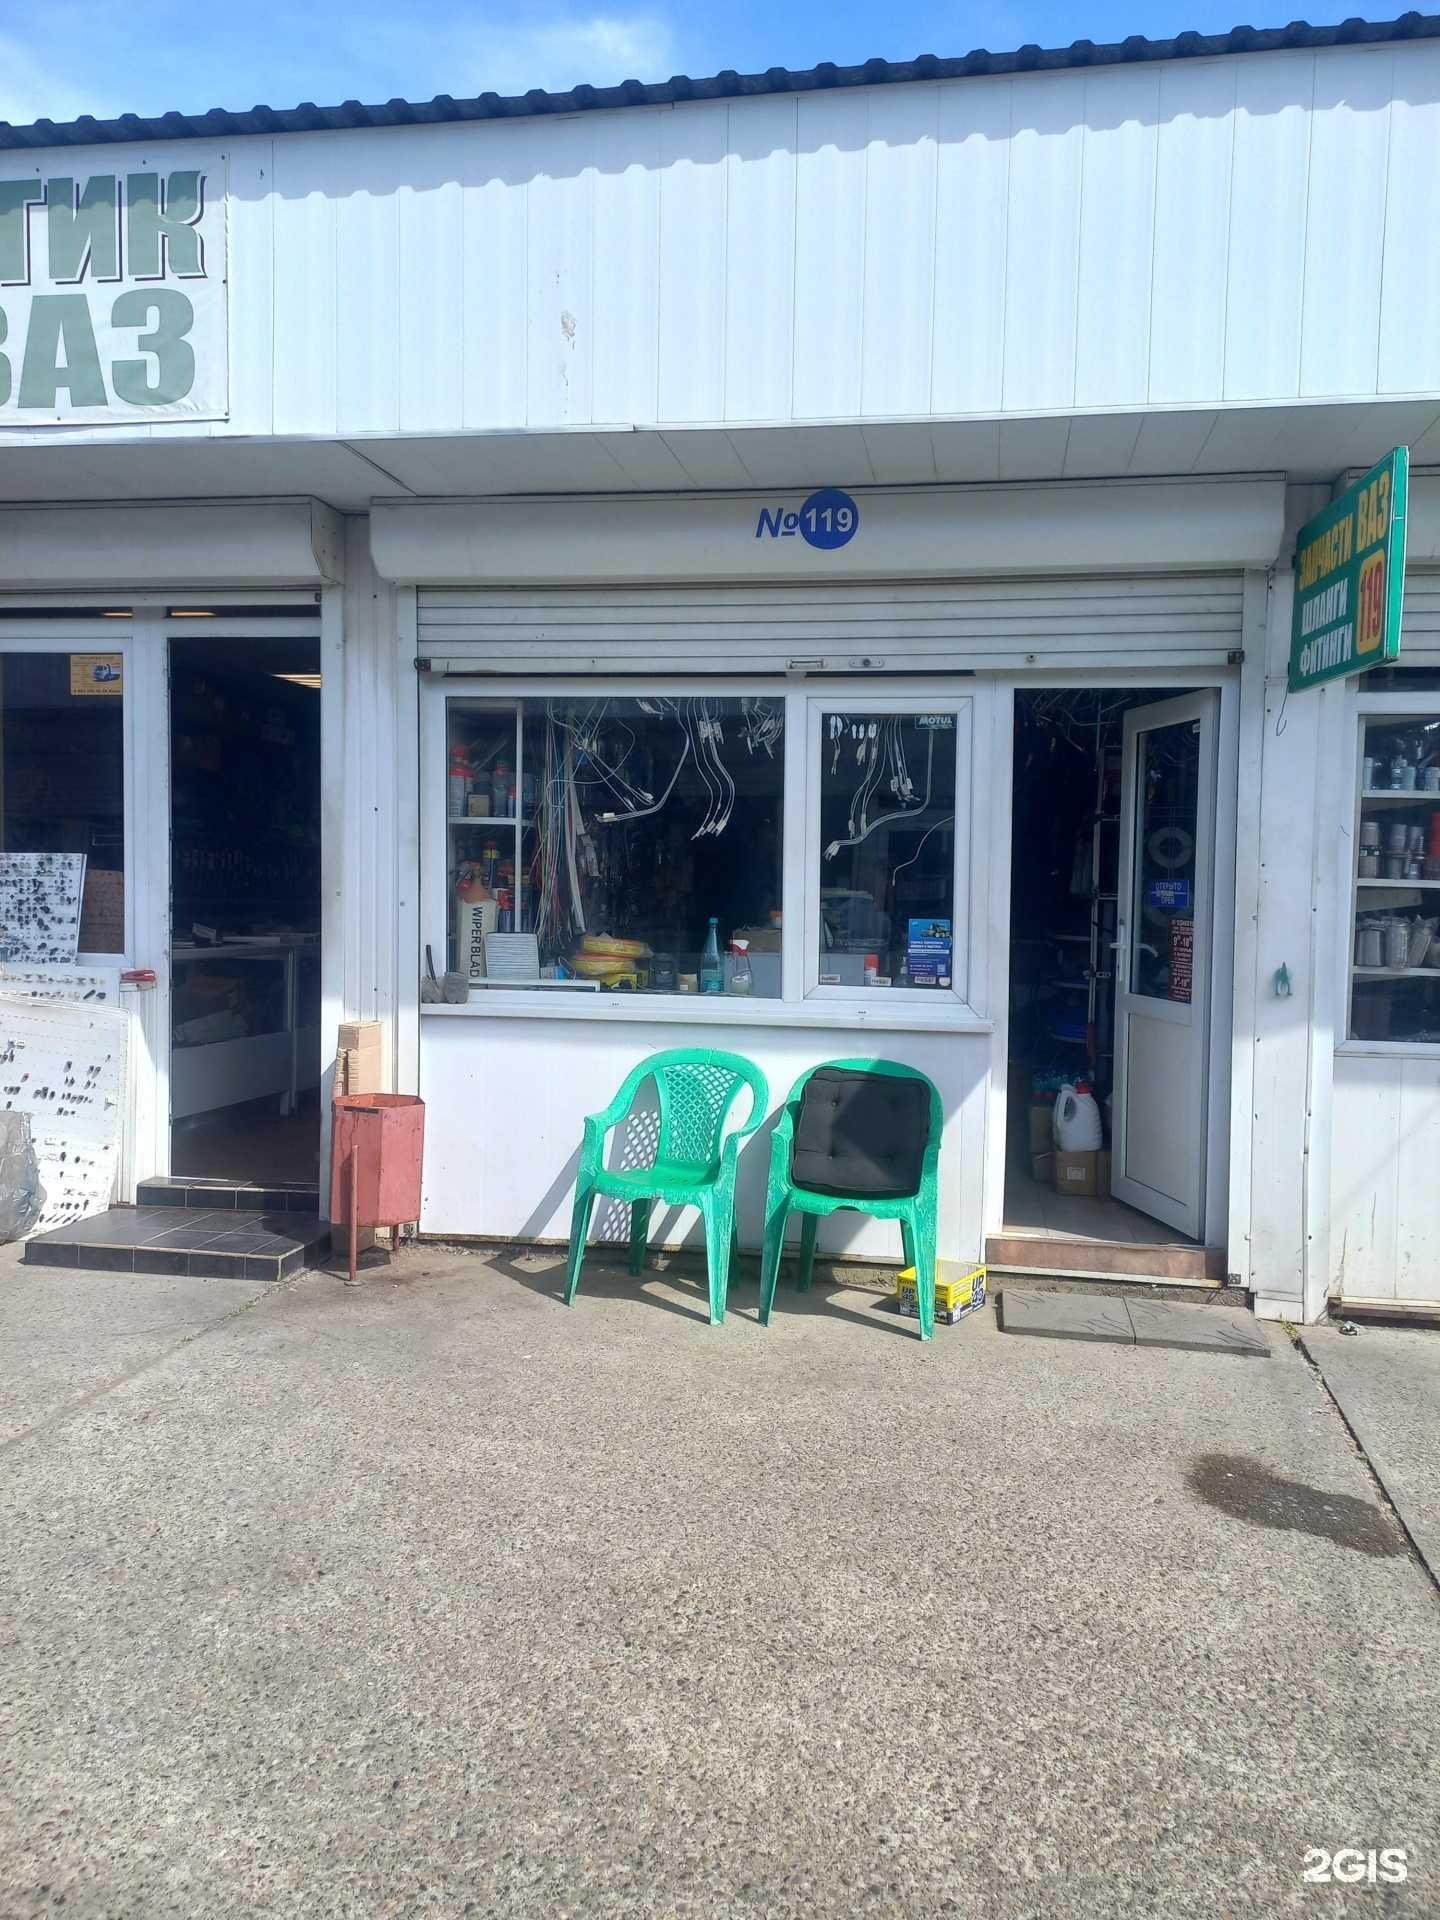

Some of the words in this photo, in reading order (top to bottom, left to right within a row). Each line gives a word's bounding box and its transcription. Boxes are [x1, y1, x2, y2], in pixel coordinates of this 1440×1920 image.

[0, 288, 195, 408] АЗ
[1299, 513, 1353, 590] ЗАПЧАСТИ
[1356, 471, 1390, 553] ВАЗ
[1301, 577, 1349, 637] ШЛАНГИ
[1360, 561, 1384, 643] 119
[1300, 622, 1353, 676] ФИТИНГИ
[919, 716, 952, 725] MOTUL
[471, 906, 483, 944] WIPER
[972, 1274, 985, 1291] UP
